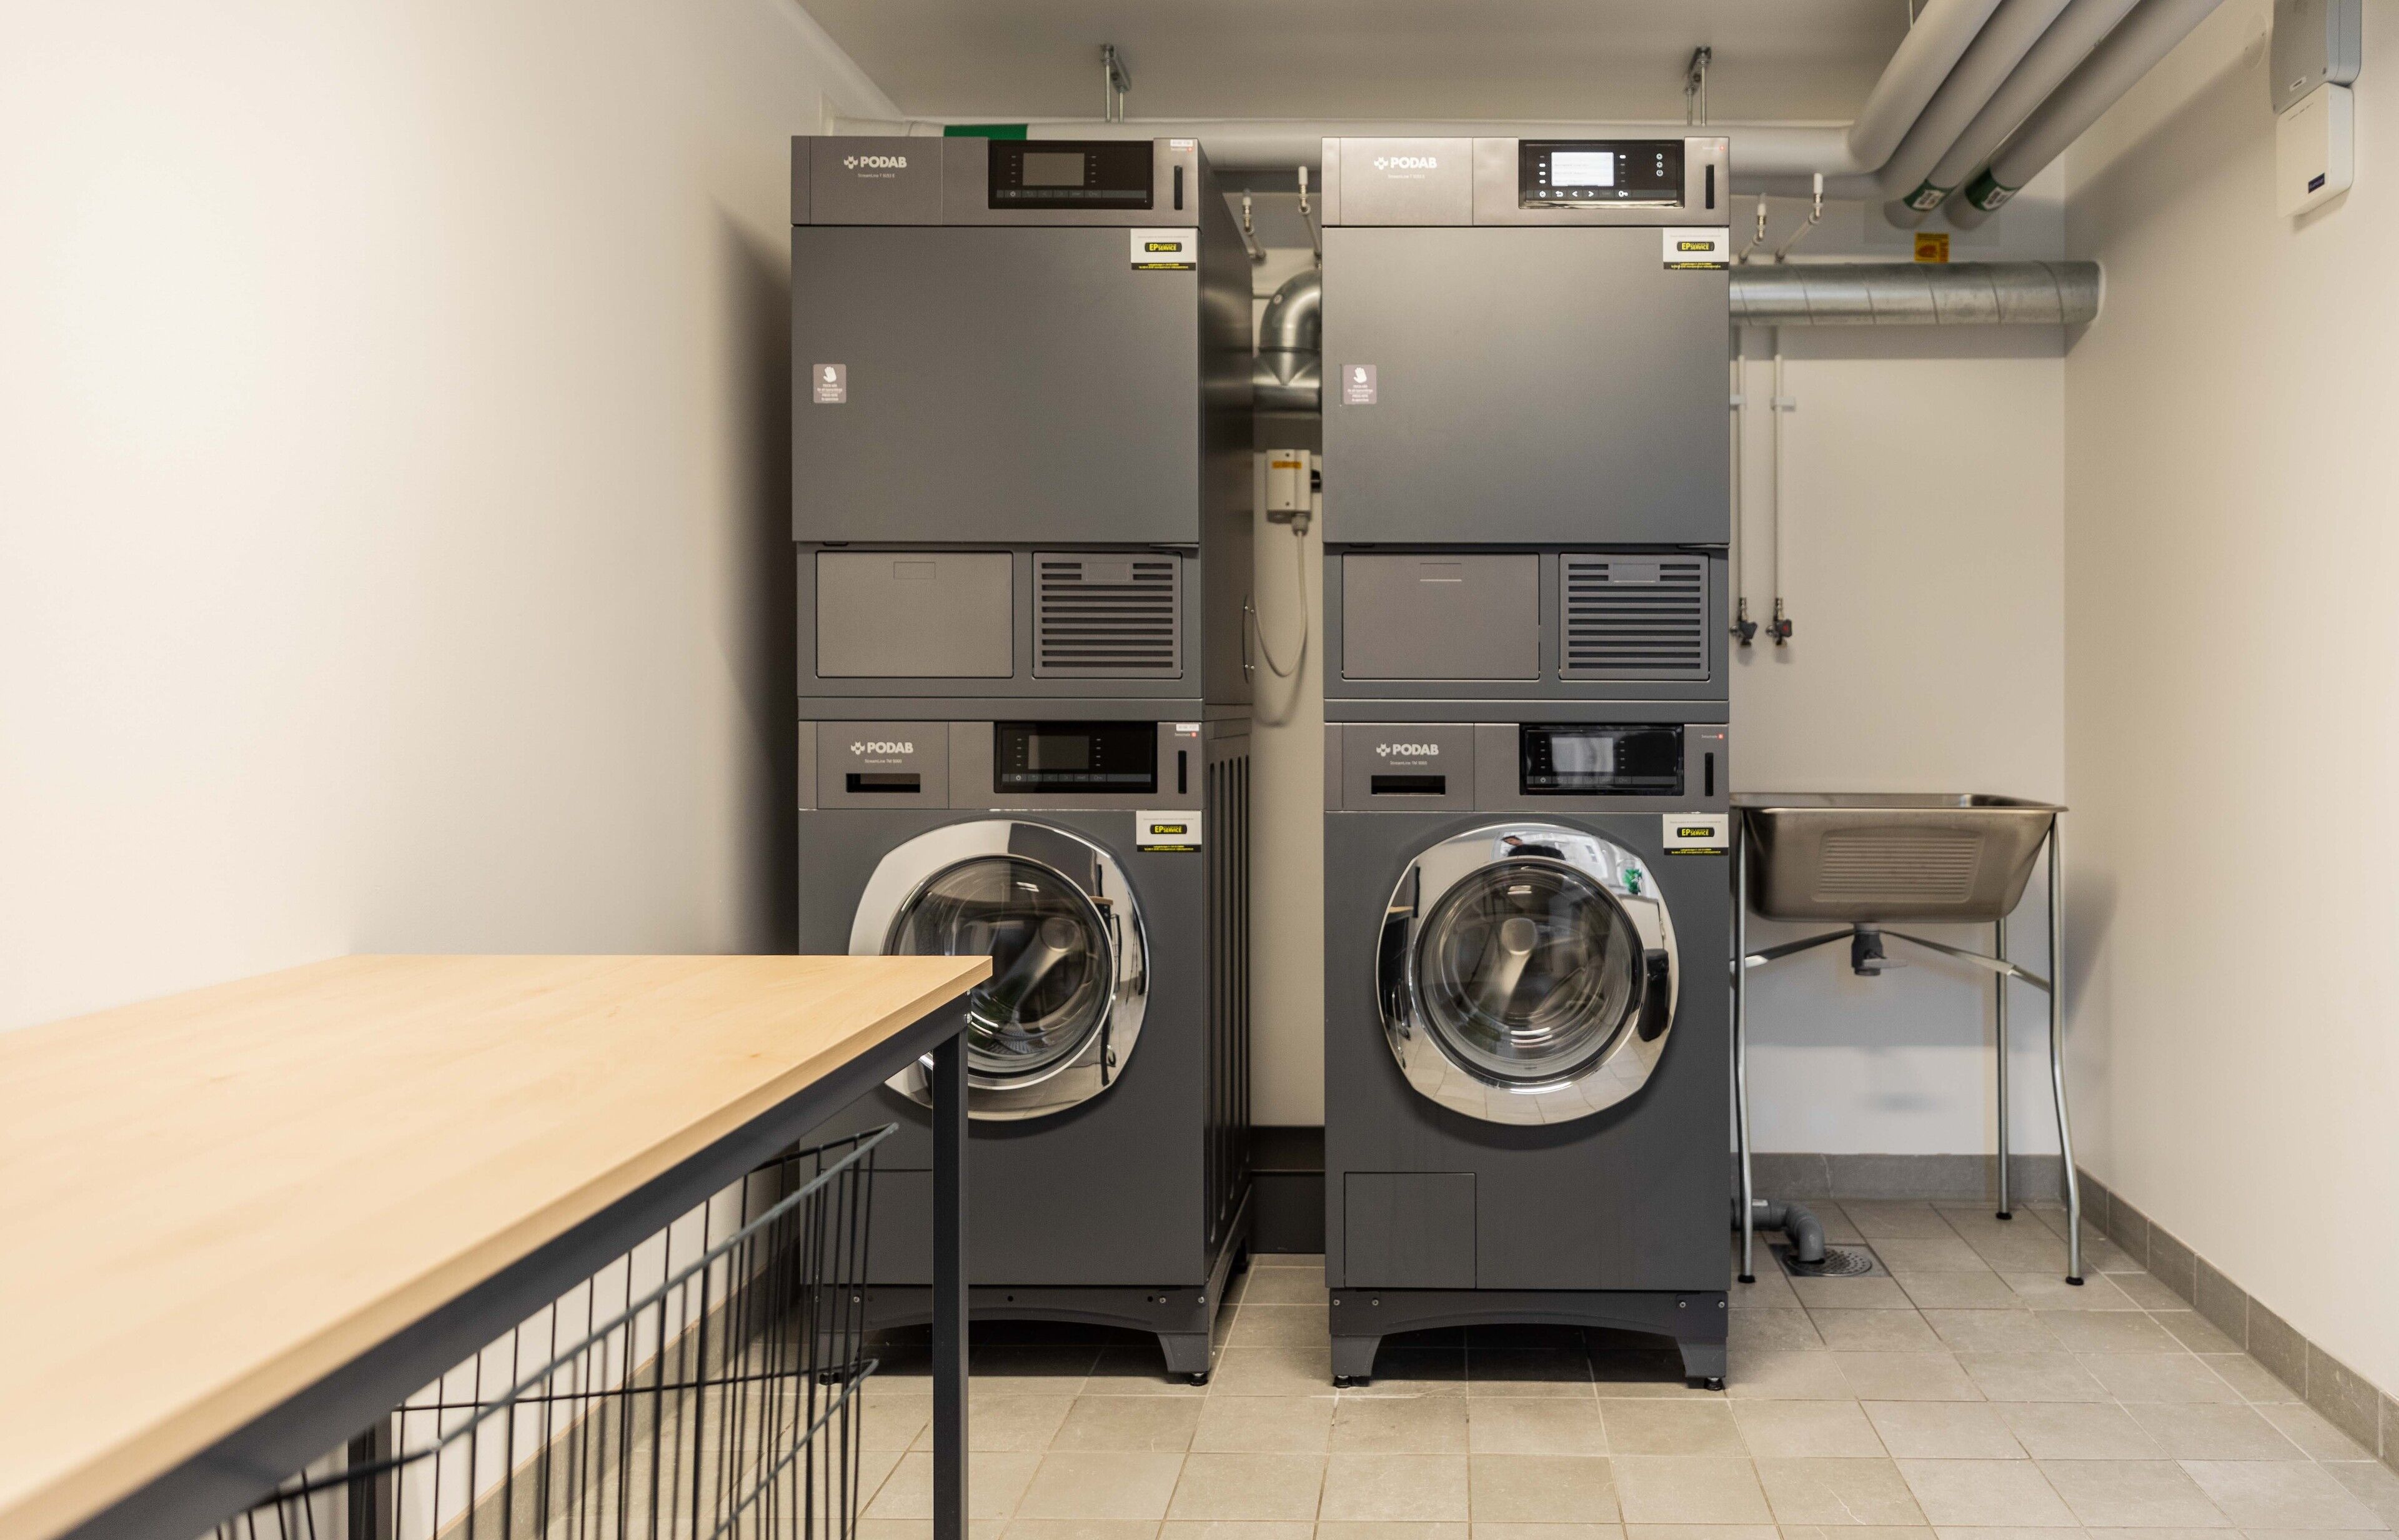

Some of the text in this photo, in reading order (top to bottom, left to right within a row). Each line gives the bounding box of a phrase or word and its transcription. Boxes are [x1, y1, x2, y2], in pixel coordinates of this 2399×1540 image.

[860, 156, 908, 169] PODAB
[1390, 156, 1438, 169] PODAB
[867, 741, 913, 753] PODAB
[1392, 743, 1439, 756] PODAB
[1681, 828, 1691, 837] EP
